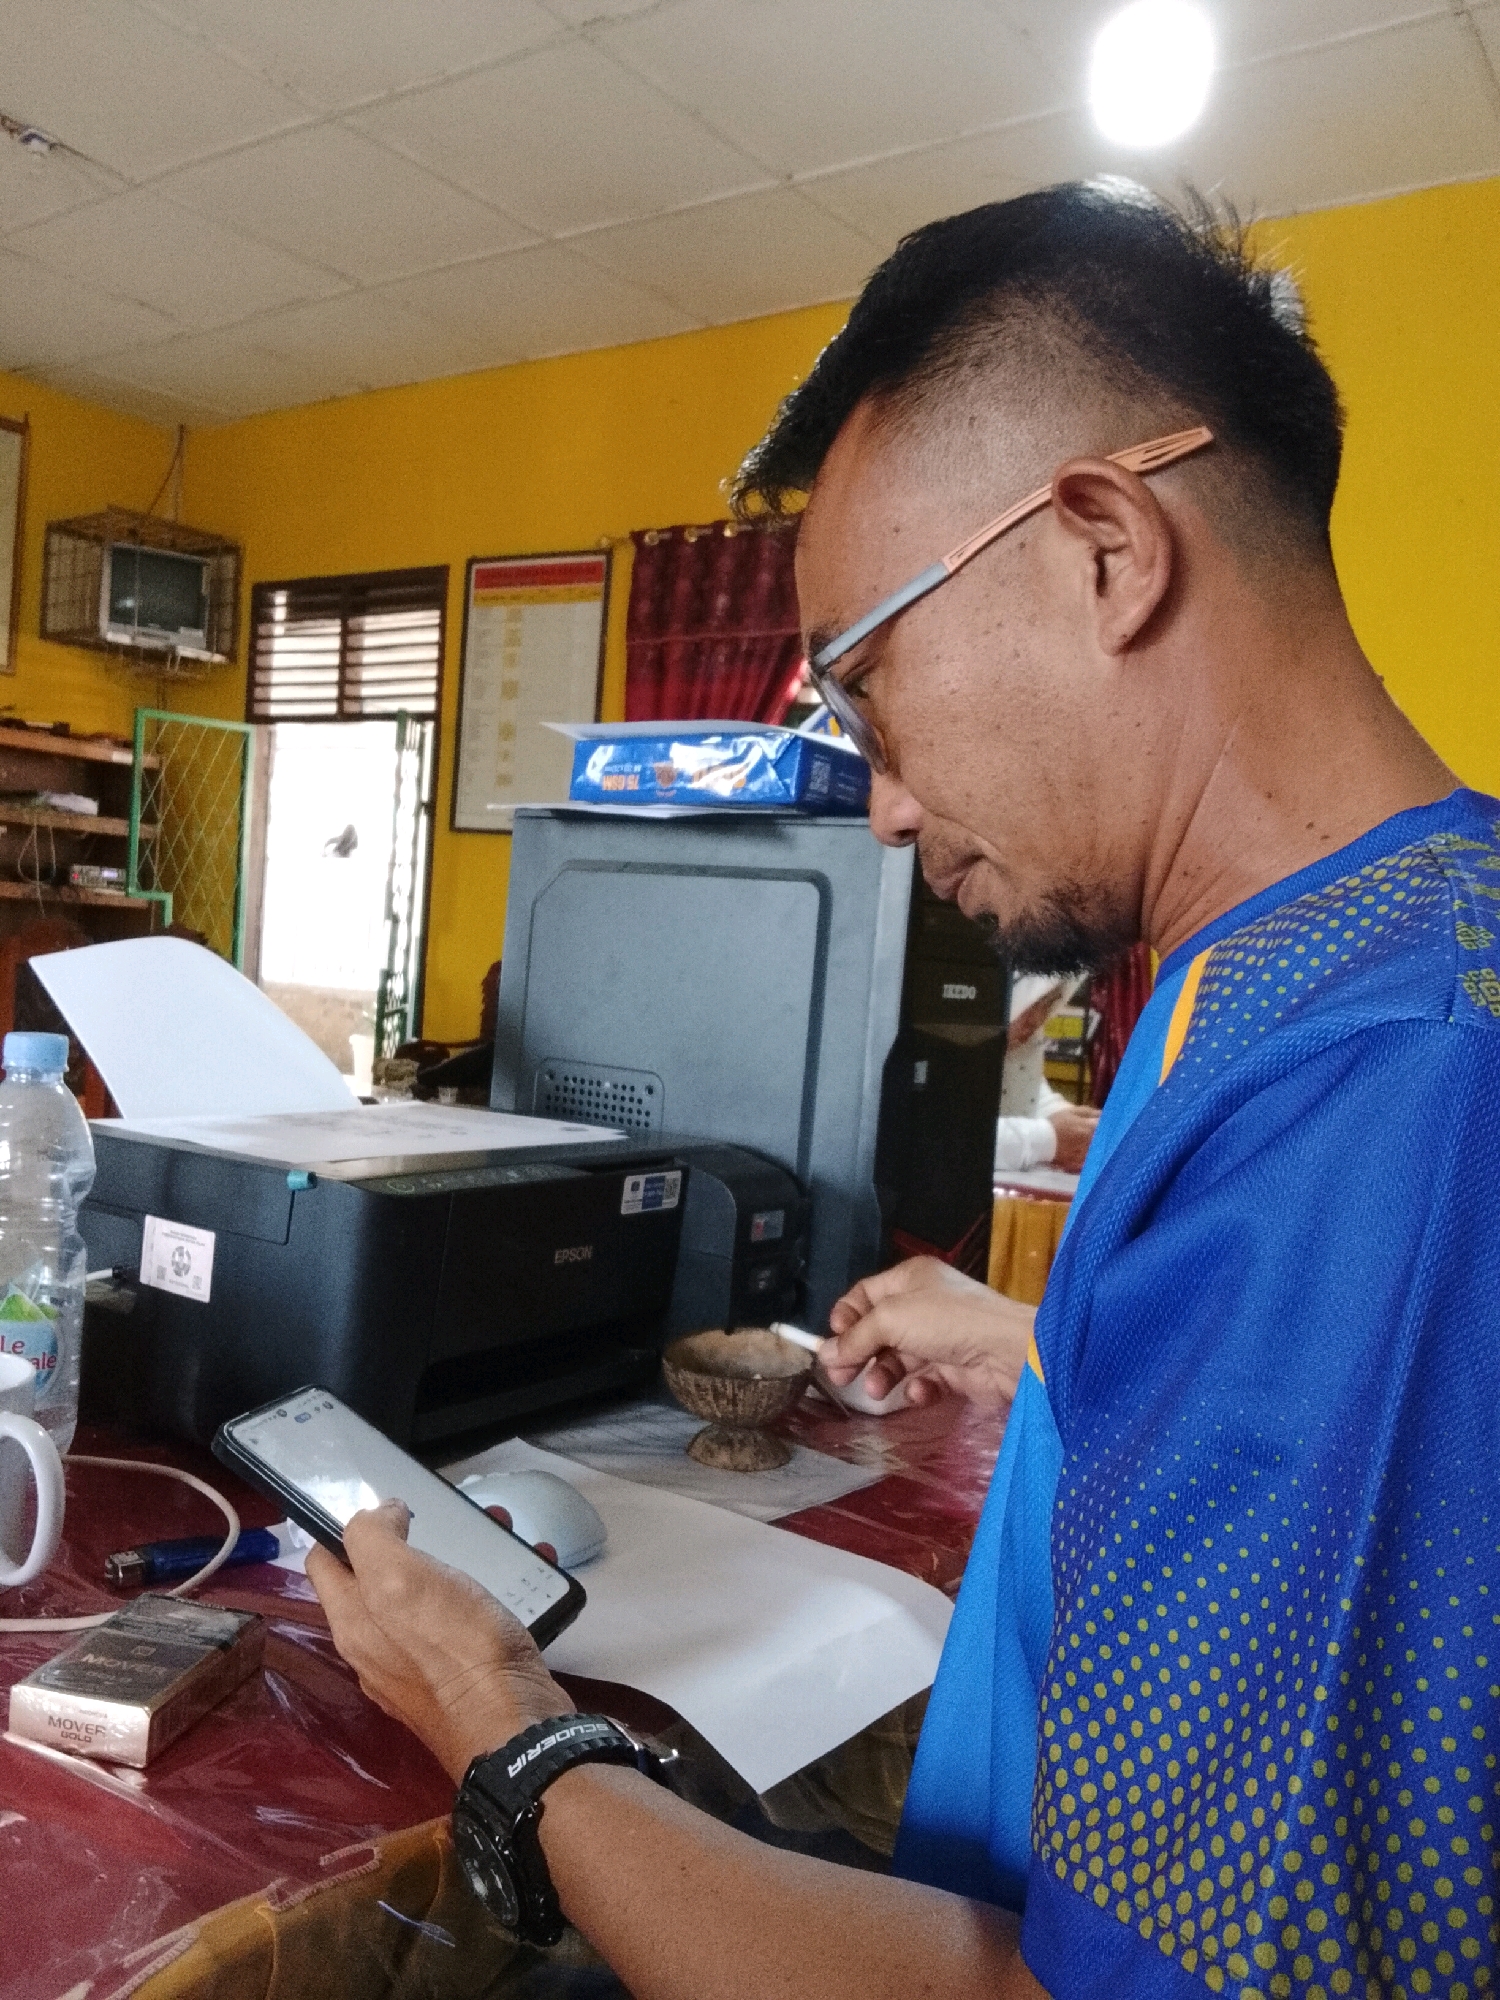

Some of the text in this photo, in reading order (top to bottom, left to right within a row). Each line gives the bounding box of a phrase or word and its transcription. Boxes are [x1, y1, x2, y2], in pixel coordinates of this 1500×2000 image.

[603, 774, 639, 790] 75 GSM
[554, 1245, 593, 1264] EPSON
[47, 1714, 106, 1737] MOVER
[61, 1730, 92, 1743] GOLD
[507, 1723, 611, 1779] SCUDERIA
